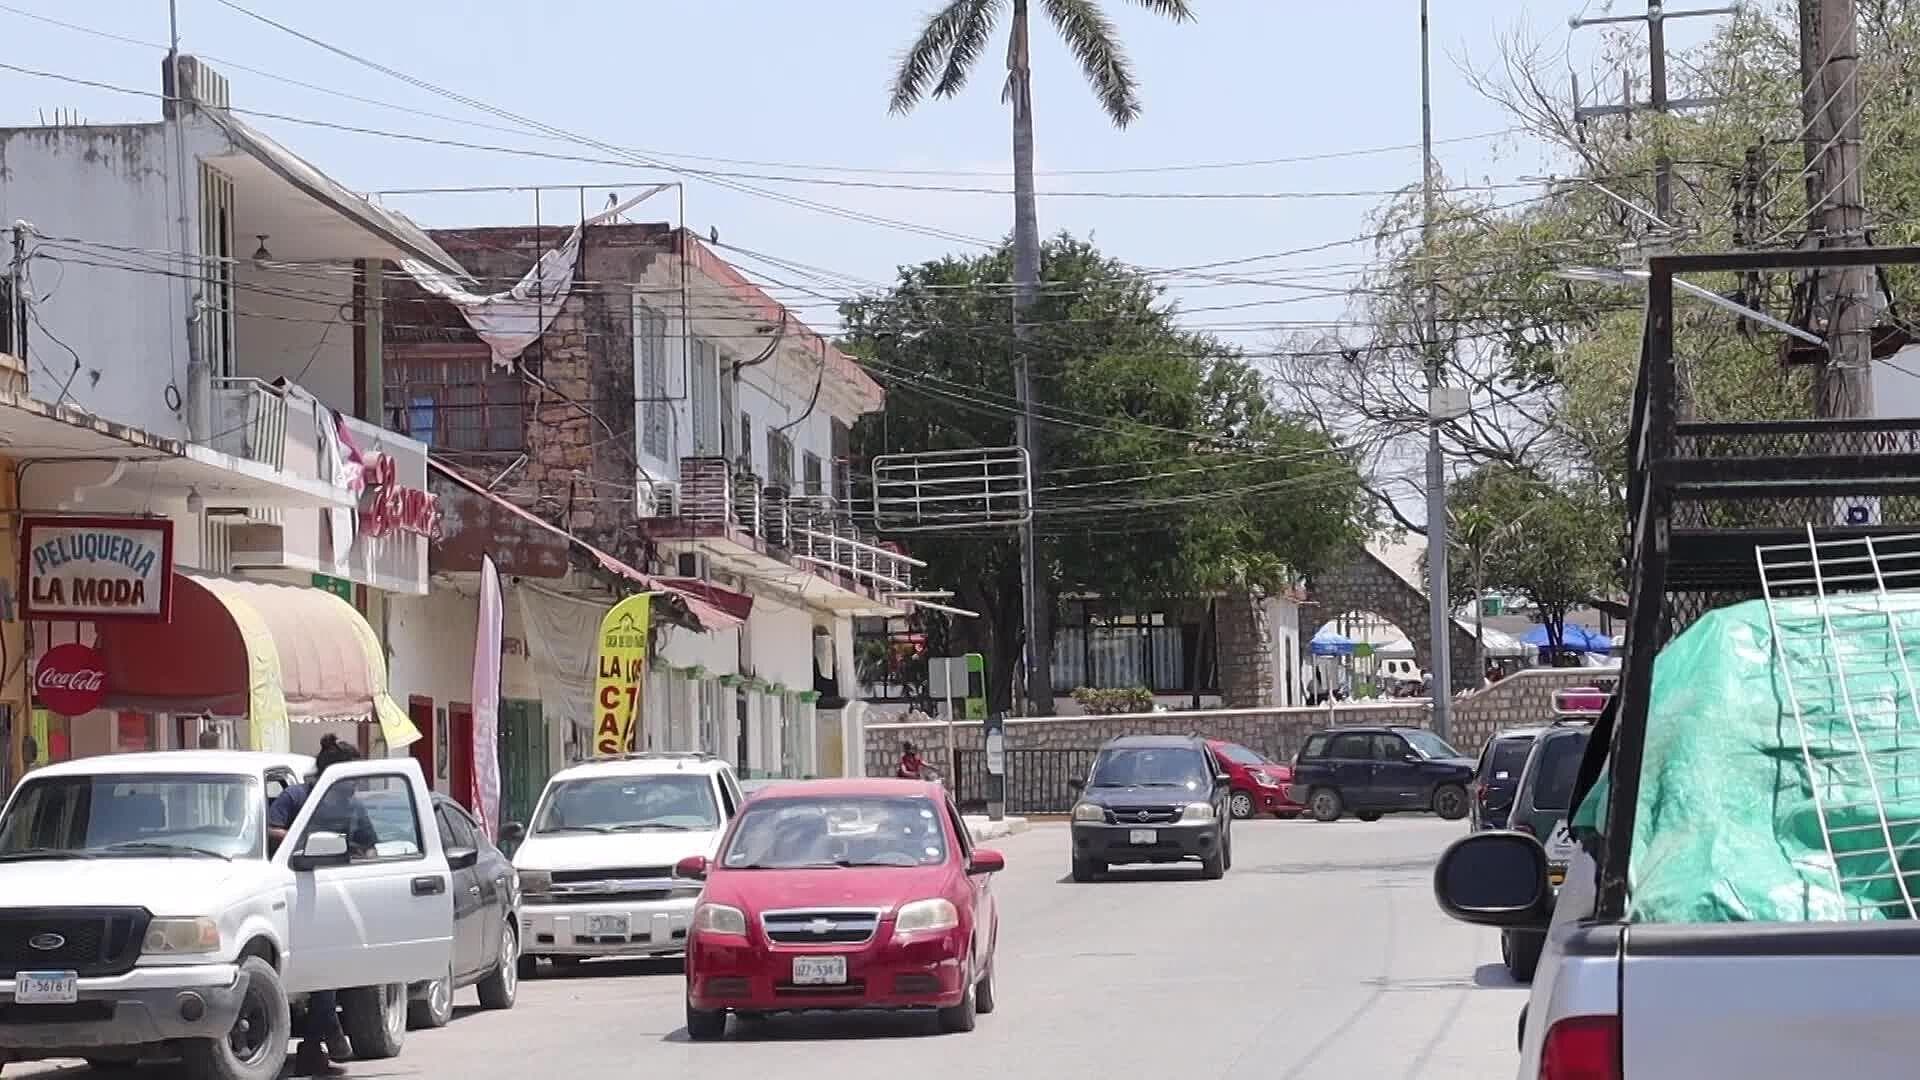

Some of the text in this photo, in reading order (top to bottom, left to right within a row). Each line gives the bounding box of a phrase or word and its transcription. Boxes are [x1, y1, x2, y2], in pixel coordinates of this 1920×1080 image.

[32, 533, 156, 578] PELUQUERIA
[32, 576, 145, 606] LA MODA
[600, 655, 621, 677] LA
